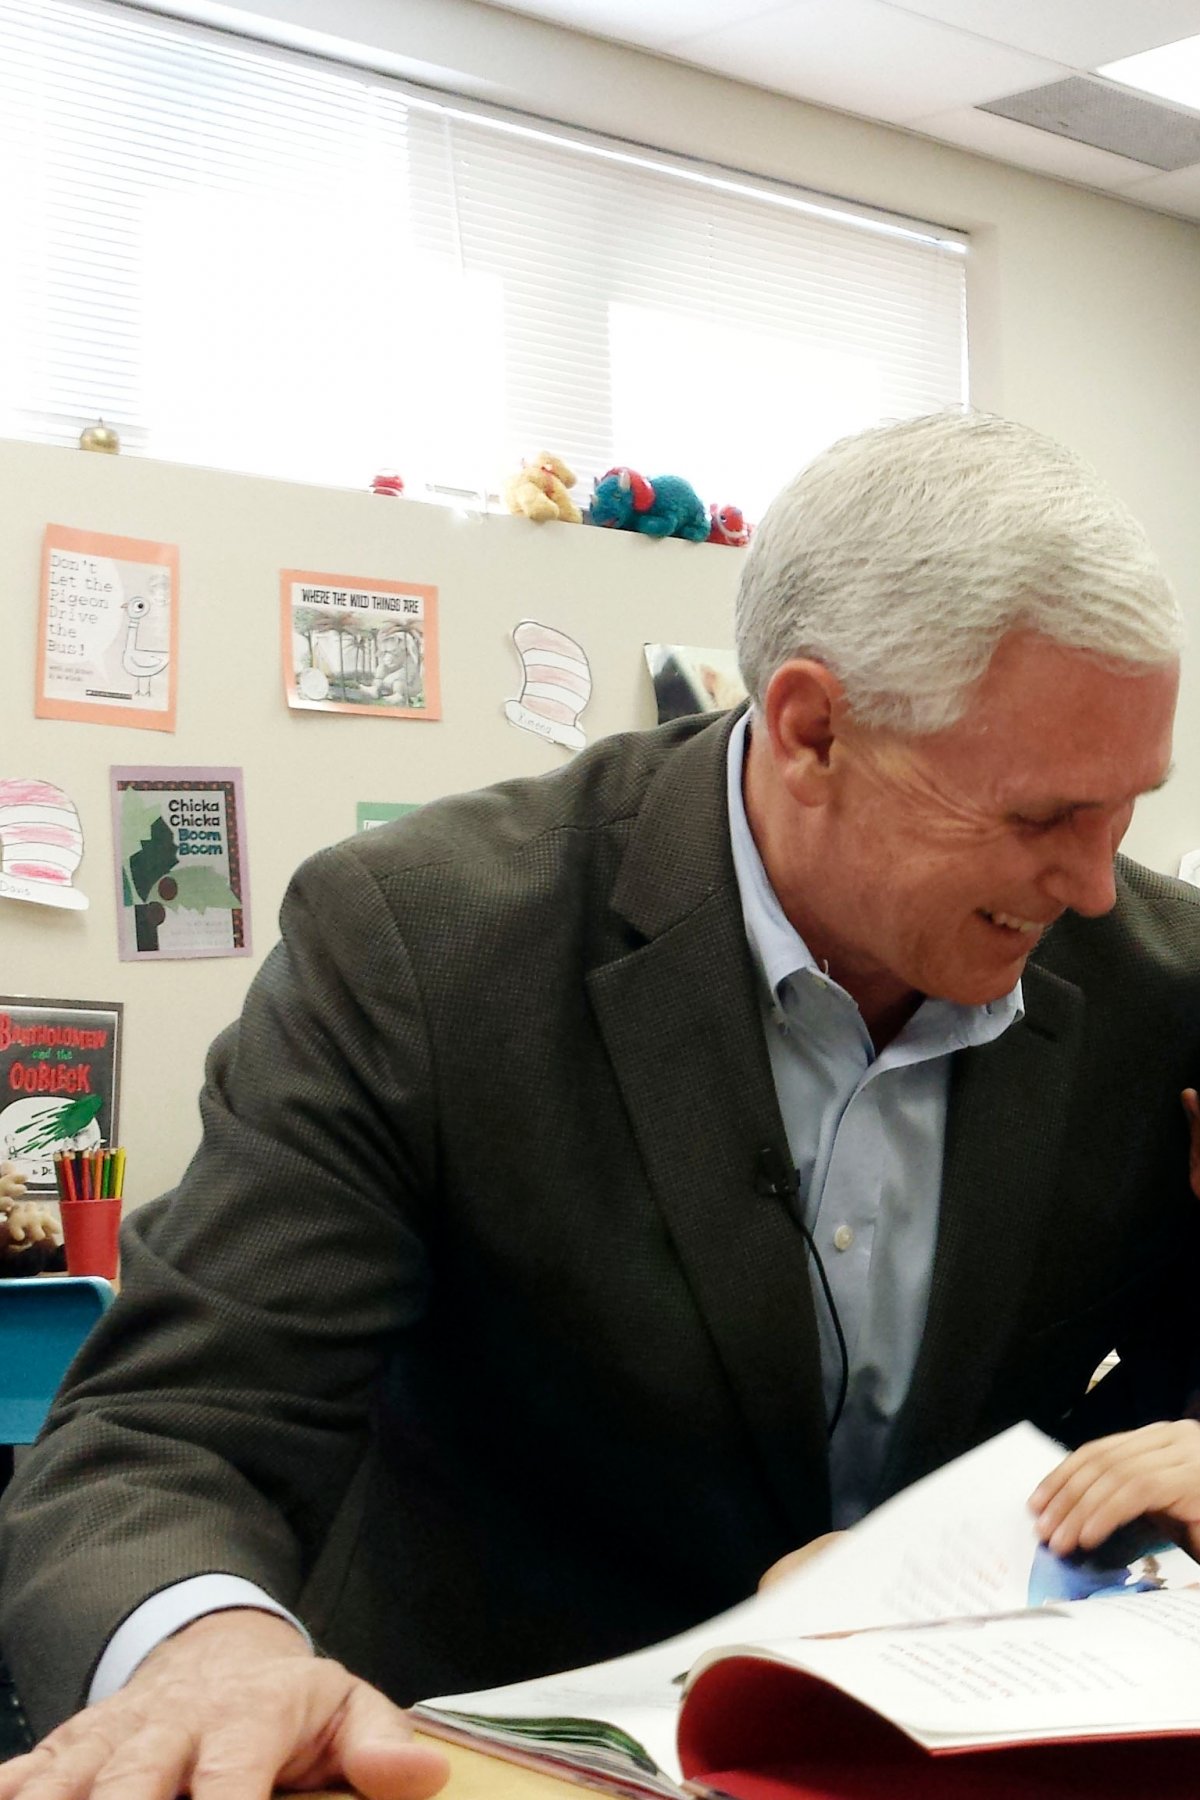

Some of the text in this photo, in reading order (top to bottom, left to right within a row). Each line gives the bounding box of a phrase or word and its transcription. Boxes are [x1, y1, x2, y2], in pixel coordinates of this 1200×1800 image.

[50, 554, 98, 575] Don't
[50, 571, 113, 592] Let the
[50, 588, 110, 610] Pigeon
[302, 588, 420, 614] WHERE THE WILD THINGS ARE
[50, 605, 98, 625] Drive
[49, 623, 78, 639] the
[48, 639, 86, 657] Bus!
[168, 799, 221, 813] Chicka
[169, 814, 221, 828] Chicka
[178, 828, 222, 842] Boom
[179, 843, 223, 856] Boom
[9, 1061, 92, 1094] OOBLECK
